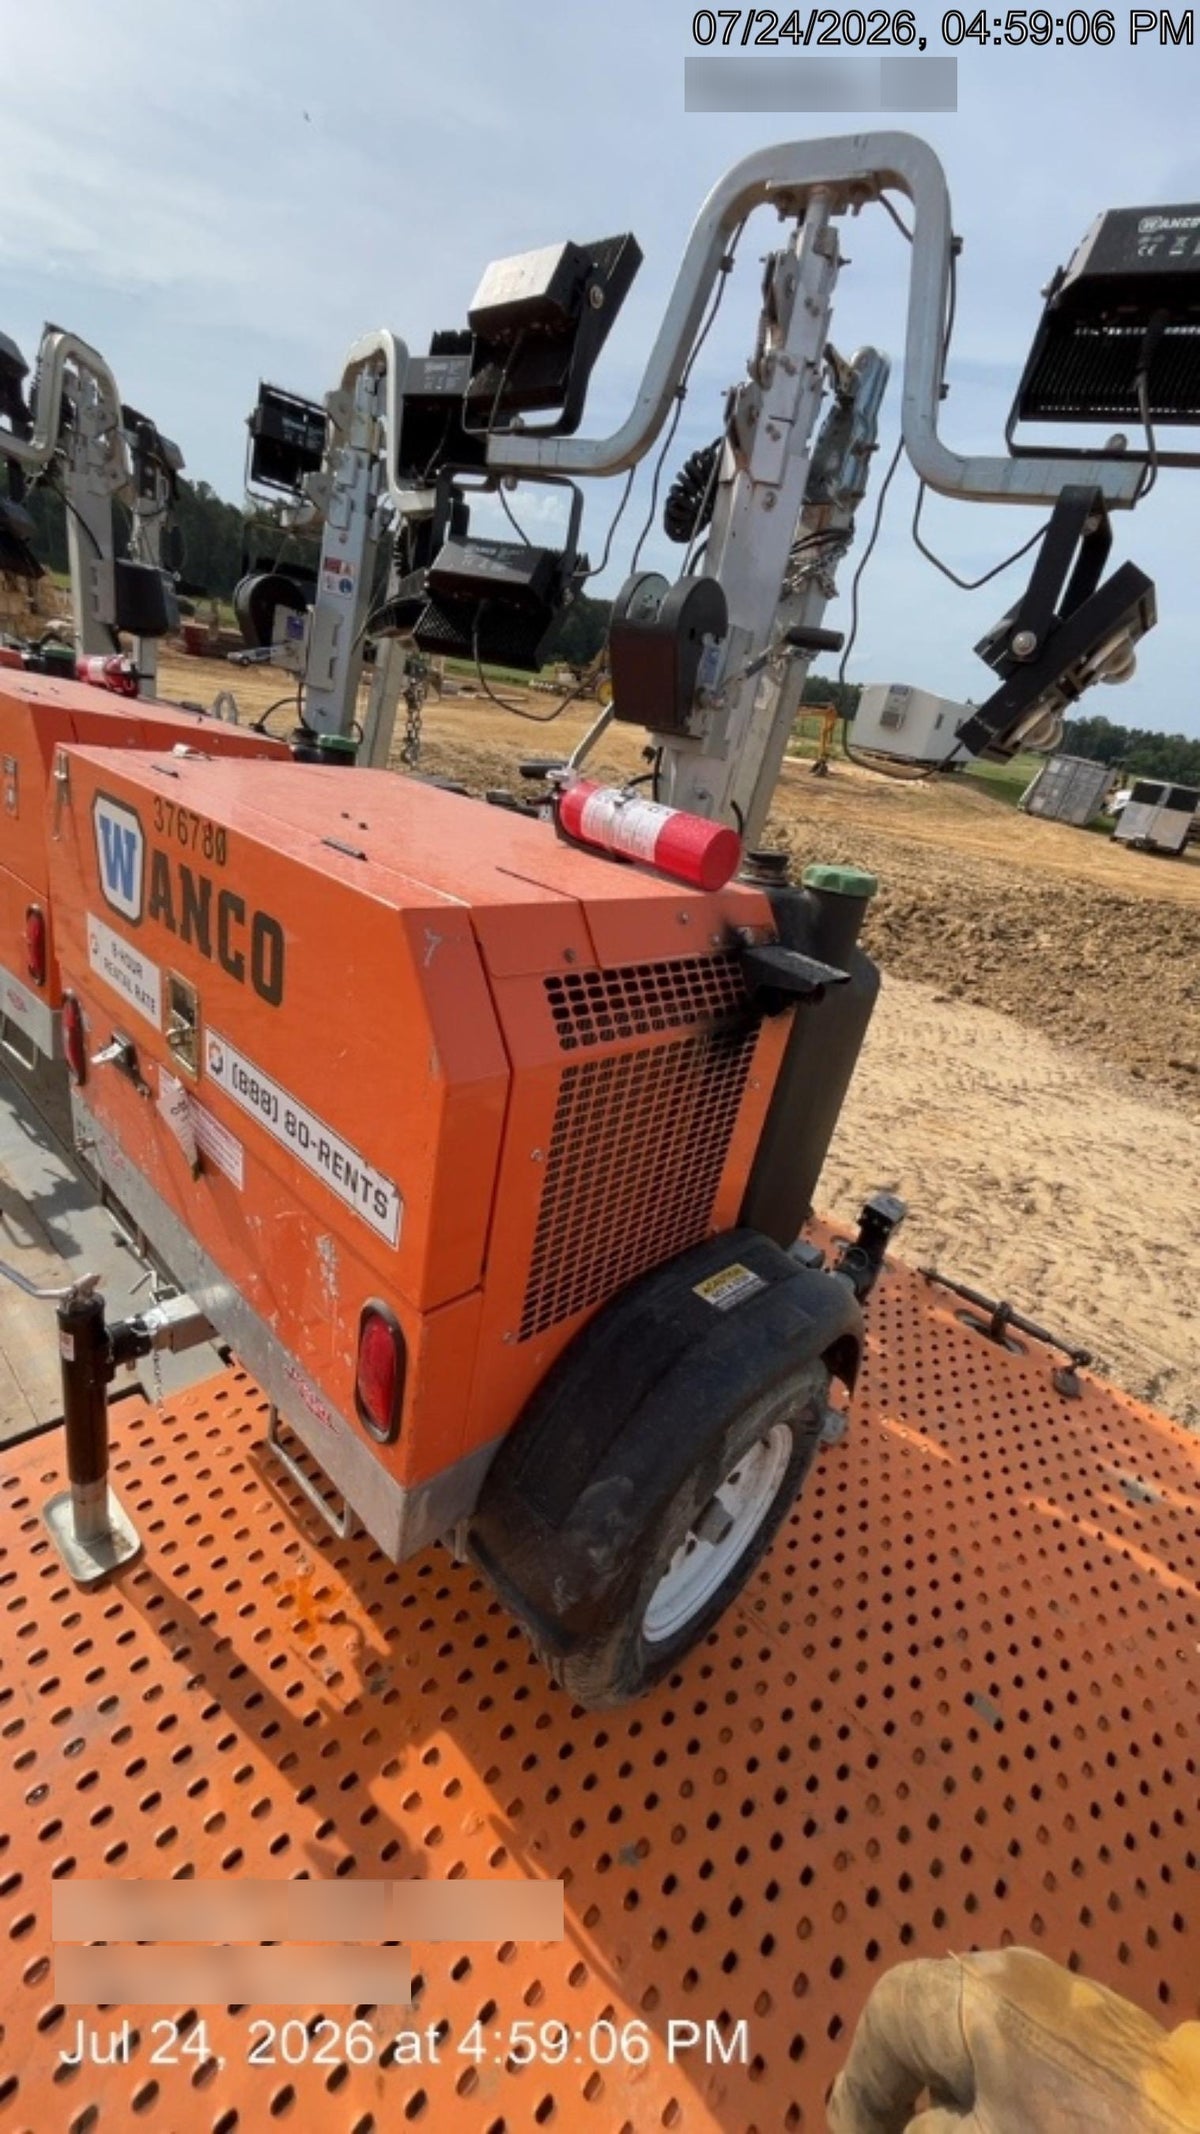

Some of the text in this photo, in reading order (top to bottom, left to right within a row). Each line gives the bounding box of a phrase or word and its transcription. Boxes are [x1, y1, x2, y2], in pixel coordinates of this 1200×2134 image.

[99, 815, 284, 1007] WANCO
[232, 1062, 279, 1124] (888)
[284, 1109, 388, 1220] 80-RENTS
